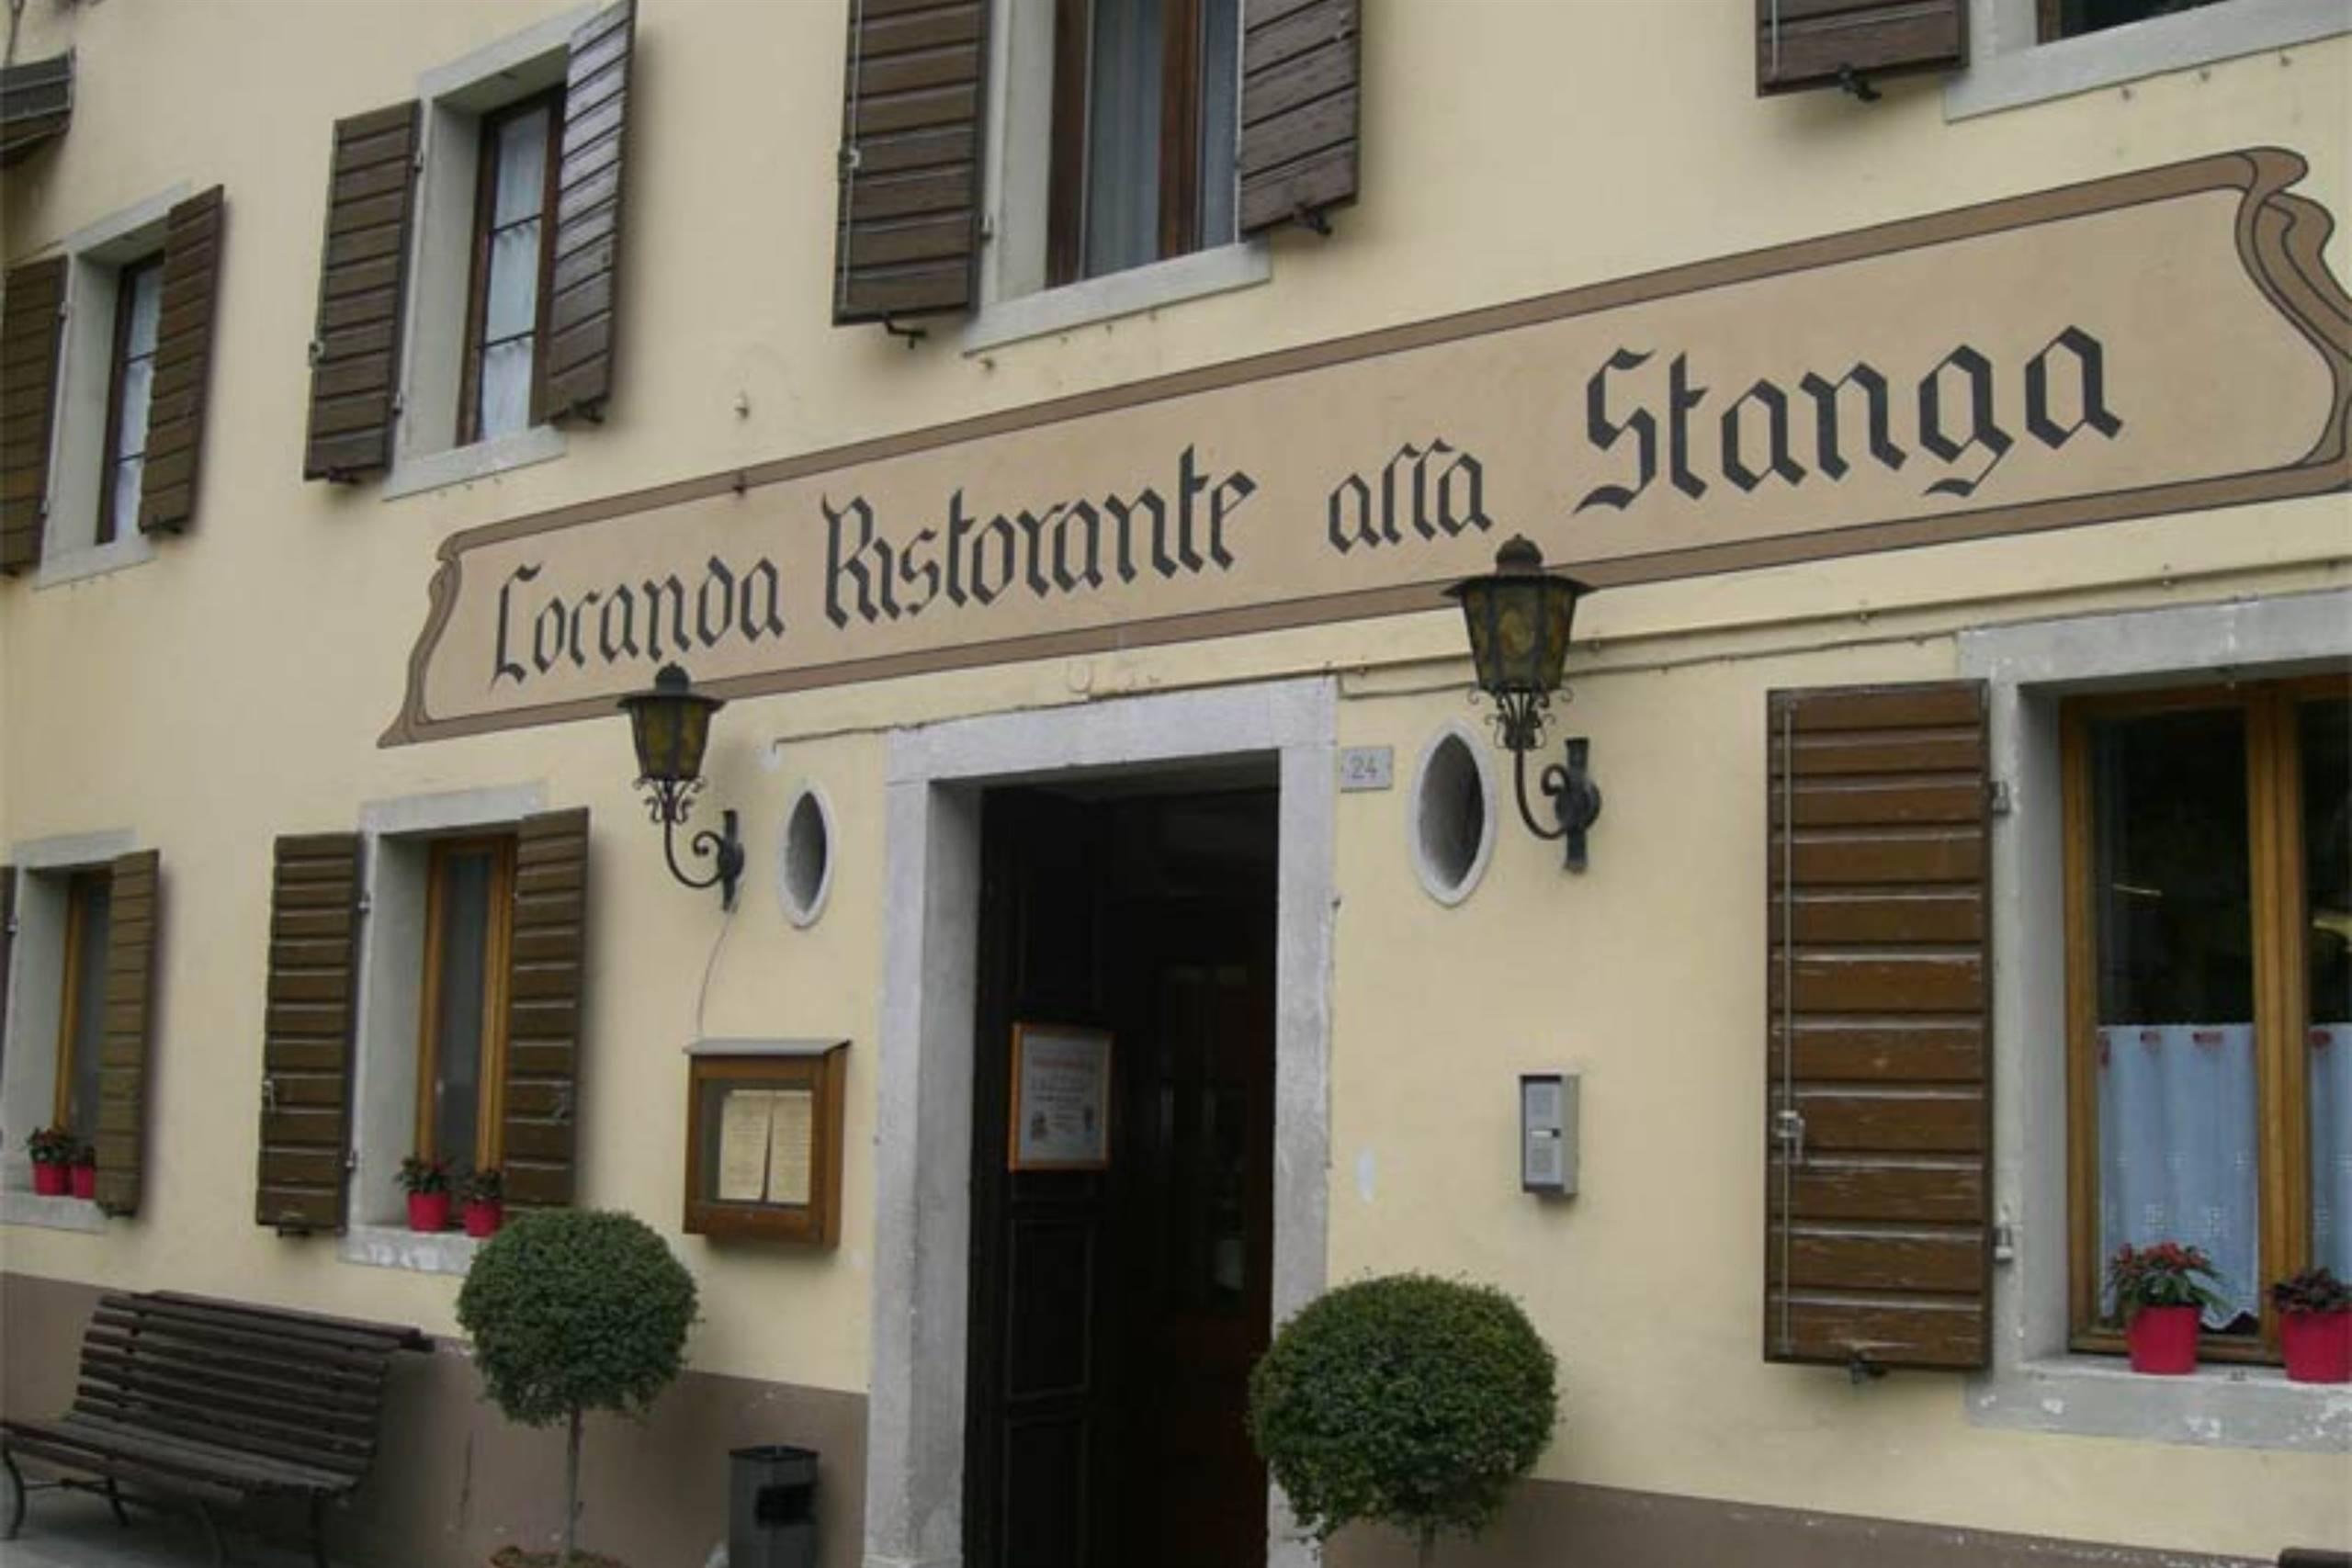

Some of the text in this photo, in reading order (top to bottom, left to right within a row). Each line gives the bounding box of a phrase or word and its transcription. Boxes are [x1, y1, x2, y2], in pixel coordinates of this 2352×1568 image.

[490, 553, 785, 692] Locanda
[822, 444, 1258, 629] Ristorante
[1573, 324, 2124, 515] Stanga
[1349, 754, 1378, 779] 24
